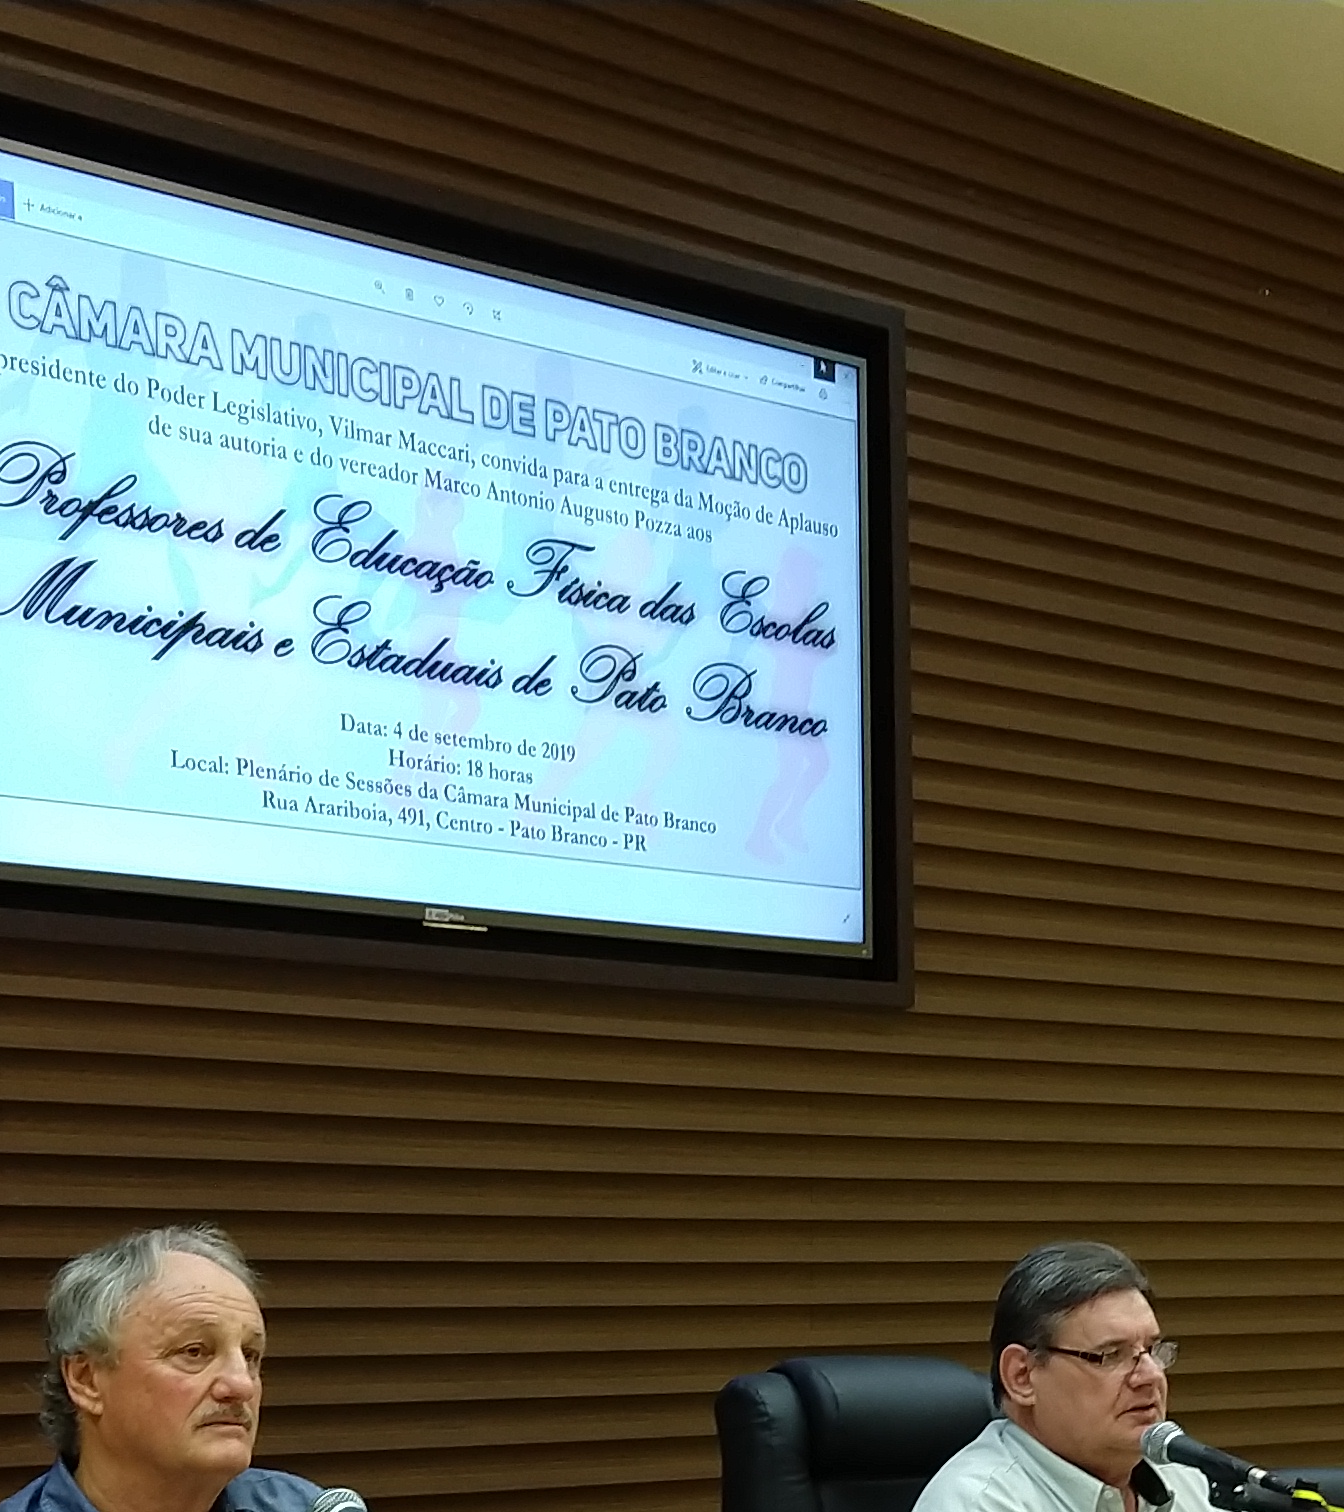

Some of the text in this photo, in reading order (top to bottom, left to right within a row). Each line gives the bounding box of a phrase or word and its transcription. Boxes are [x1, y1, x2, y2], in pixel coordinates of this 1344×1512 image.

[8, 275, 809, 494] CÂMARA MUNICIPAL DE PATO BRANCO
[113, 372, 139, 396] do
[147, 377, 205, 410] Poder
[212, 391, 324, 438] Legislativo,
[329, 414, 392, 447] Vilmar
[397, 431, 476, 468] Maccari,
[481, 452, 548, 480] convida
[553, 467, 590, 490] para
[594, 475, 605, 490] a
[609, 478, 671, 507] entrega
[674, 486, 694, 509] da
[698, 492, 751, 522] Moção
[755, 503, 774, 525] de
[777, 508, 839, 539] Aplauso
[148, 415, 713, 544] de sua autoria e do vereador Marco Antonio Augusto Pozza aos
[234, 508, 288, 554] de
[312, 494, 495, 594] Educação
[639, 581, 696, 626] das
[720, 571, 837, 650] Escolas
[273, 635, 295, 658] e
[311, 595, 503, 689] Estaduais
[511, 655, 558, 697] de
[571, 644, 668, 714] Pato
[686, 662, 828, 738] Branco
[170, 749, 717, 834] Local: Plenário de Sessões da Câmara Municipal de Pato Branco
[340, 713, 576, 762] Data: 4 de setembro de 2019
[388, 749, 534, 785] Horário: 18 horas
[262, 790, 299, 813] Rua
[304, 795, 393, 826] Arariboia,
[397, 806, 431, 831] 491,
[436, 811, 493, 835] Centro
[509, 820, 546, 841] Pato
[551, 825, 607, 848] Branco
[623, 833, 647, 852] PR
